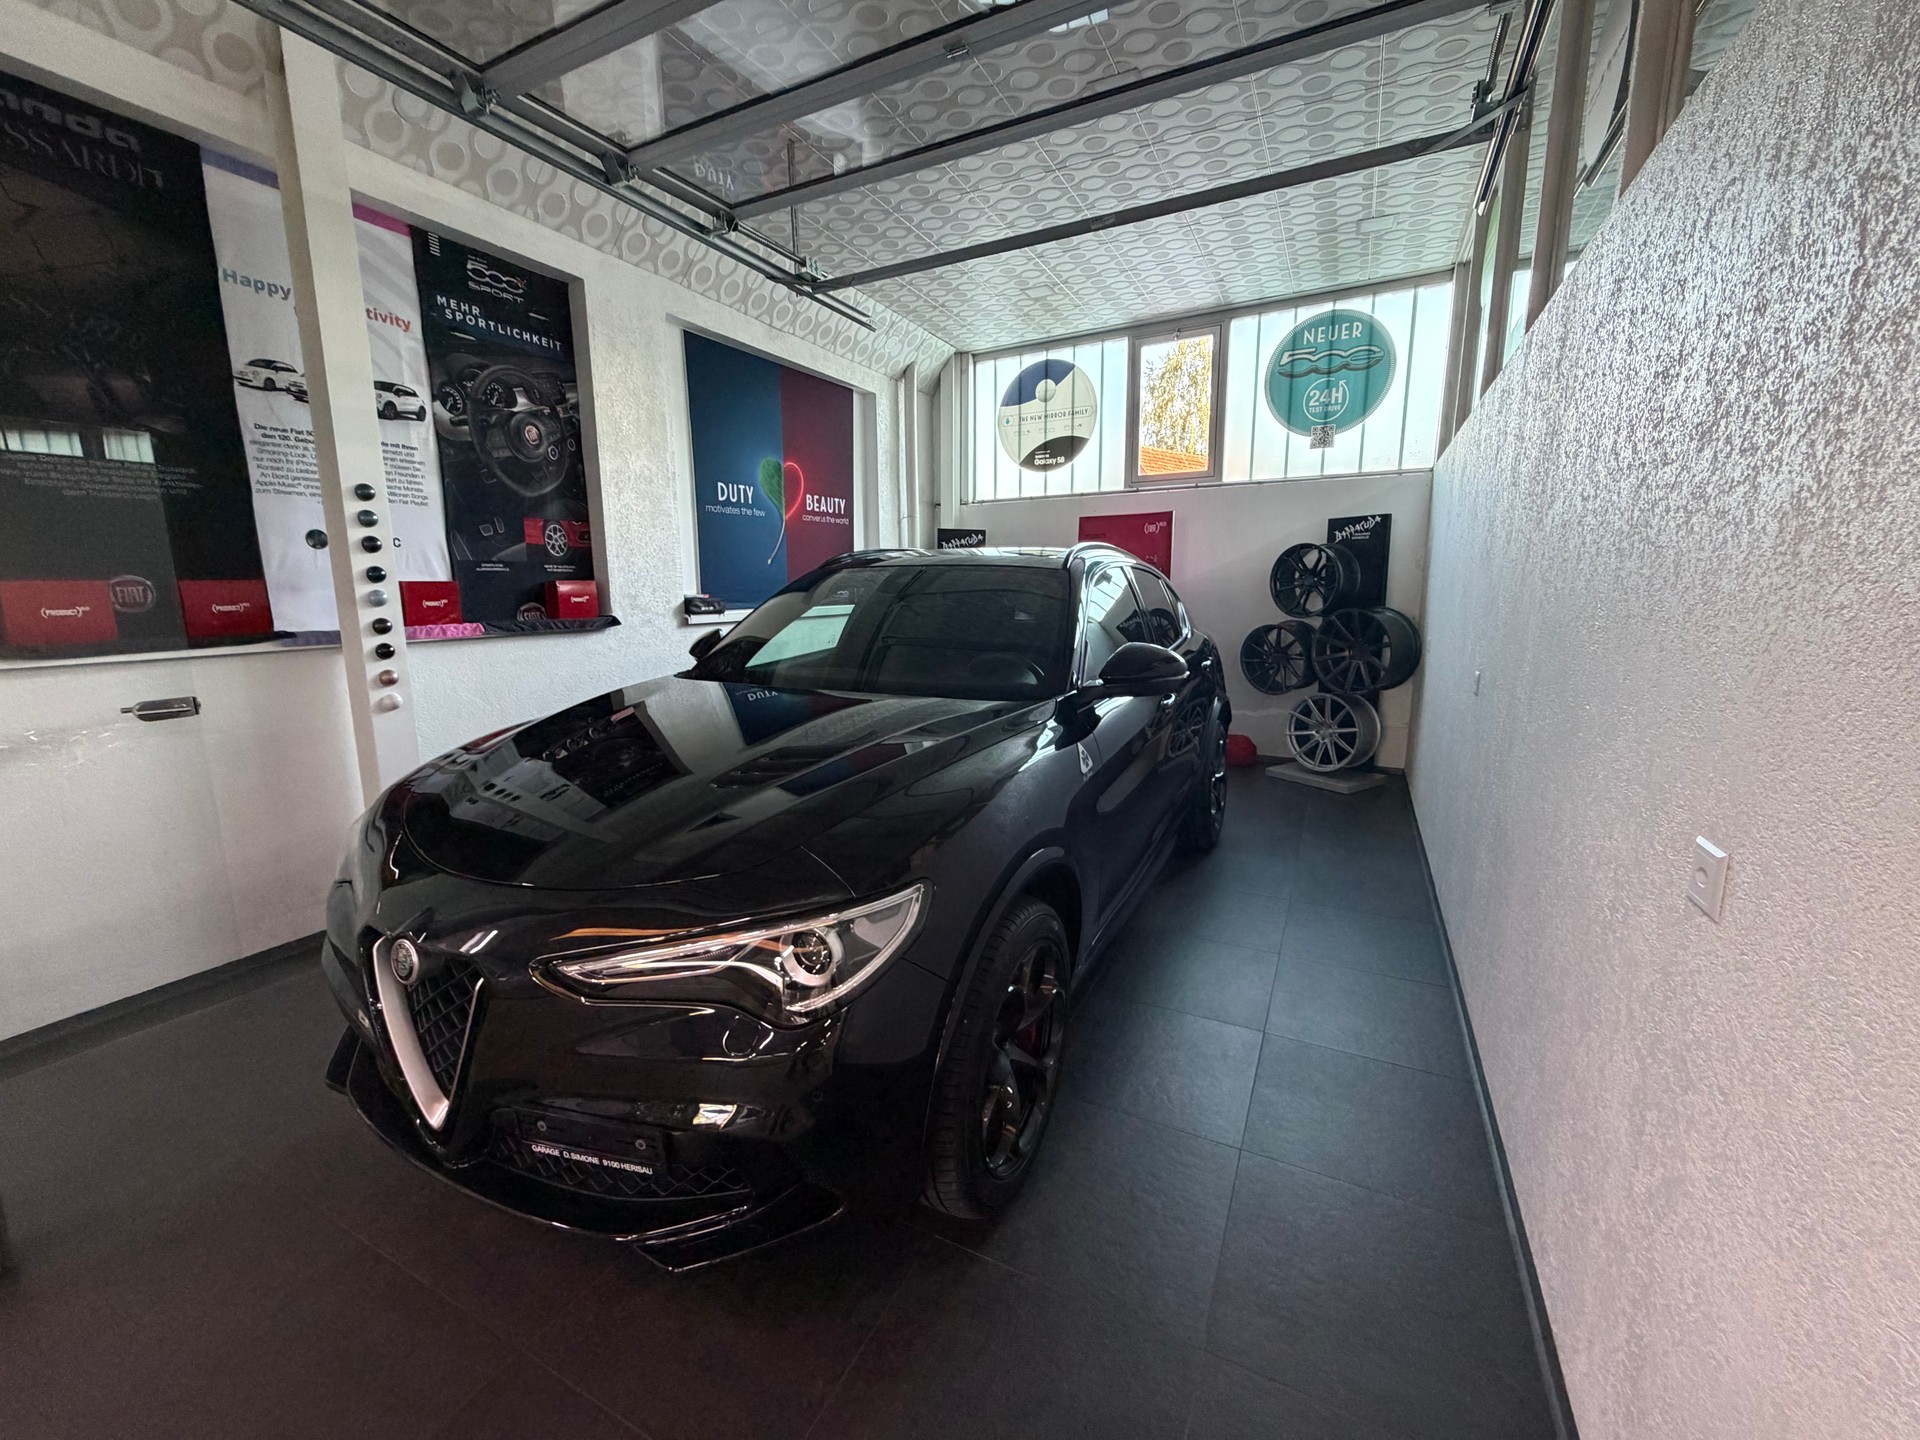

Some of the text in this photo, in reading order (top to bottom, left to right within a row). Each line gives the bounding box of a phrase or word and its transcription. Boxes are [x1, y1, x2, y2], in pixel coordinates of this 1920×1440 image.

[222, 268, 292, 300] Happy
[468, 281, 525, 304] SPORT
[437, 295, 480, 317] MEHR
[365, 307, 411, 332] tivity
[445, 309, 562, 351] SPORTLICHKEIT
[1303, 322, 1363, 345] NEUER
[1309, 387, 1344, 406] 24H
[1019, 409, 1089, 423] THE NEW MIRROR FAMILY
[290, 428, 305, 436] Fiat
[1034, 456, 1066, 466] Galaxy S8
[717, 482, 754, 504] DUTY
[805, 493, 846, 515] BEAUTY
[705, 505, 766, 517] motivates the few
[826, 515, 835, 524] the
[1334, 515, 1382, 543] BARRACUDA
[116, 586, 145, 603] FIAT
[531, 1144, 560, 1157] GARAGE
[602, 1159, 620, 1169] 9100
[620, 1163, 653, 1175] HERISAU
